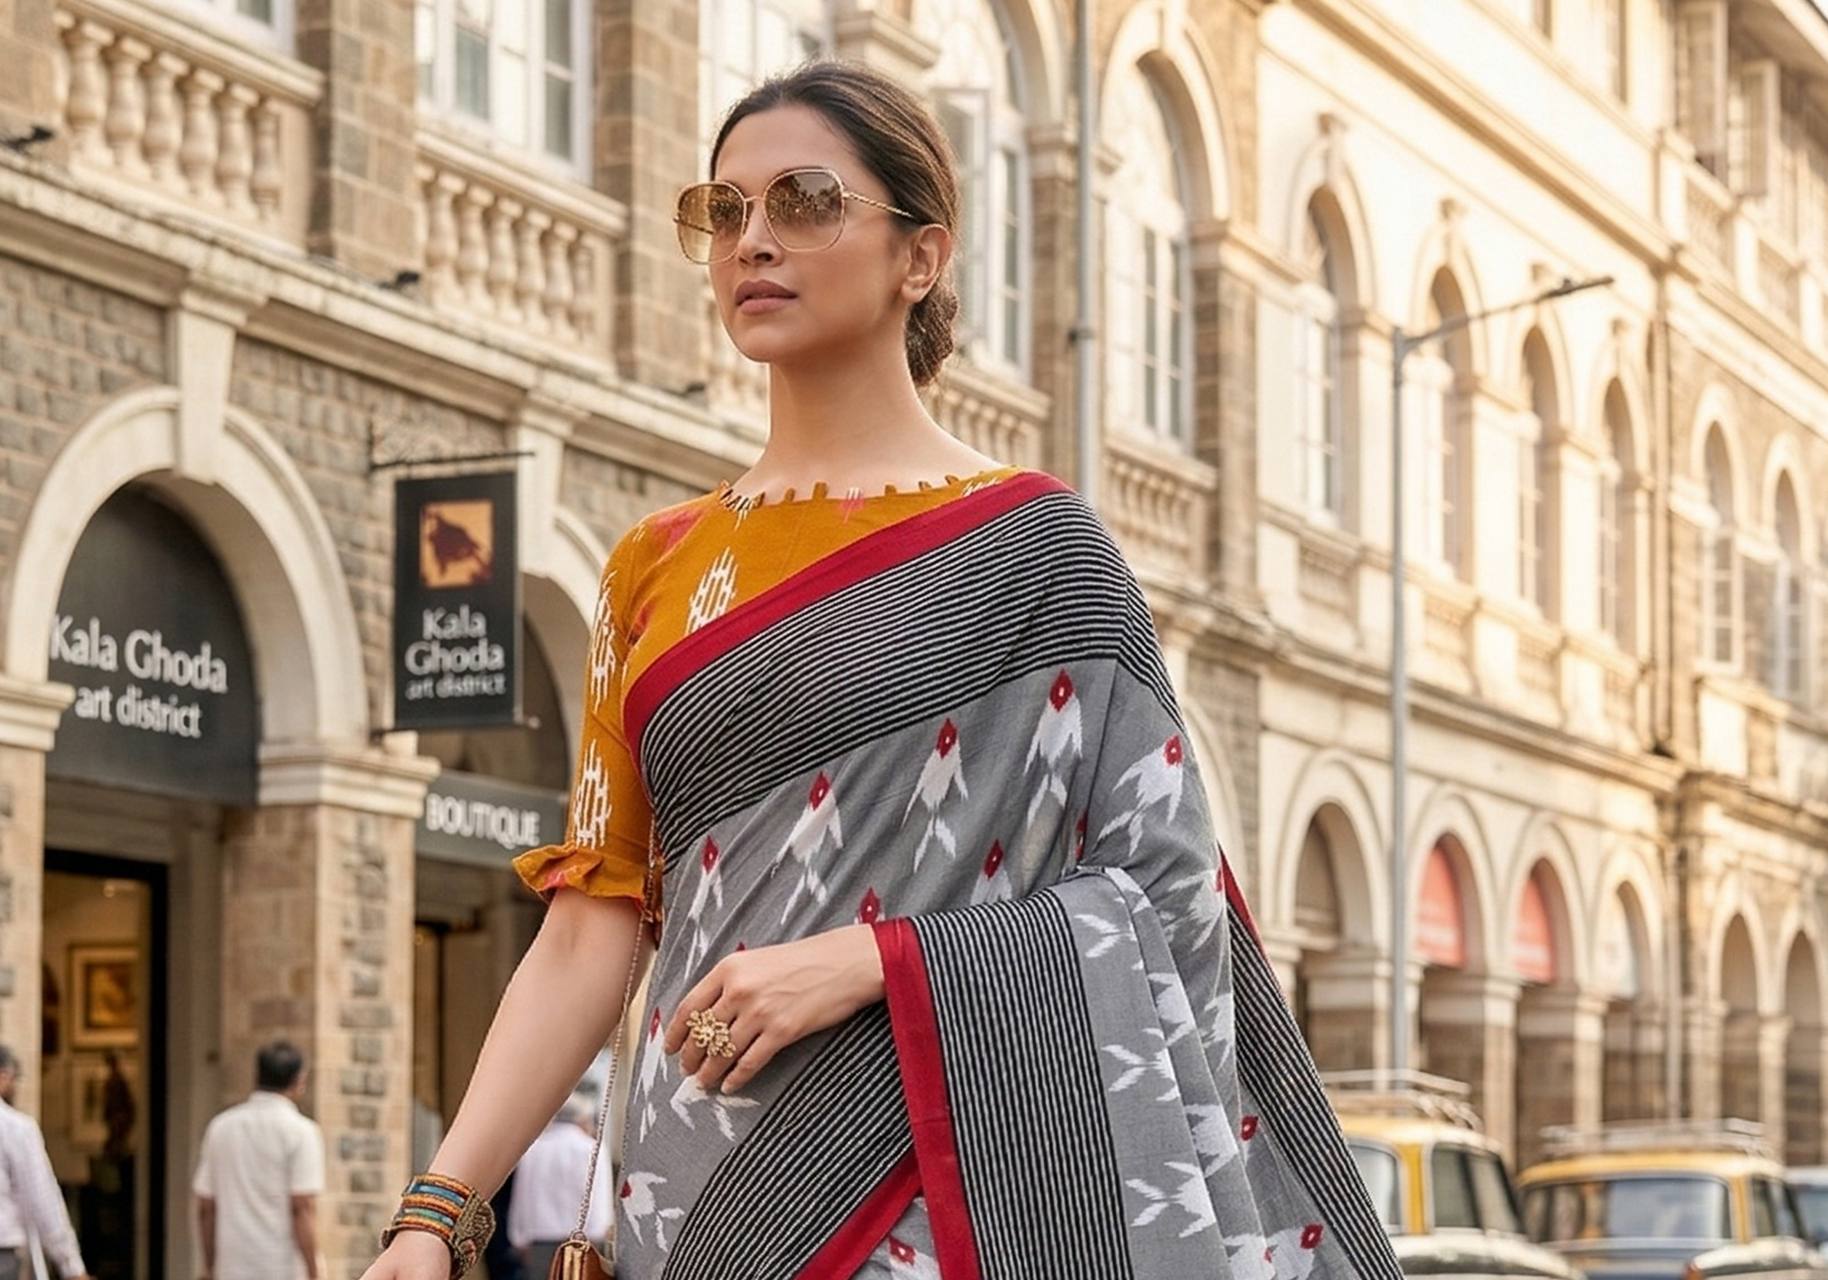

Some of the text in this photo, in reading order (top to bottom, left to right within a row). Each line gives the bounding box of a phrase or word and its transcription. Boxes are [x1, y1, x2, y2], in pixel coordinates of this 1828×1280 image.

[422, 604, 487, 640] Kala
[50, 615, 229, 694] Kala Ghoda
[404, 638, 505, 675] Ghoda
[405, 673, 506, 700] art district
[75, 684, 202, 738] art district
[426, 793, 540, 850] BOUTIQUE
